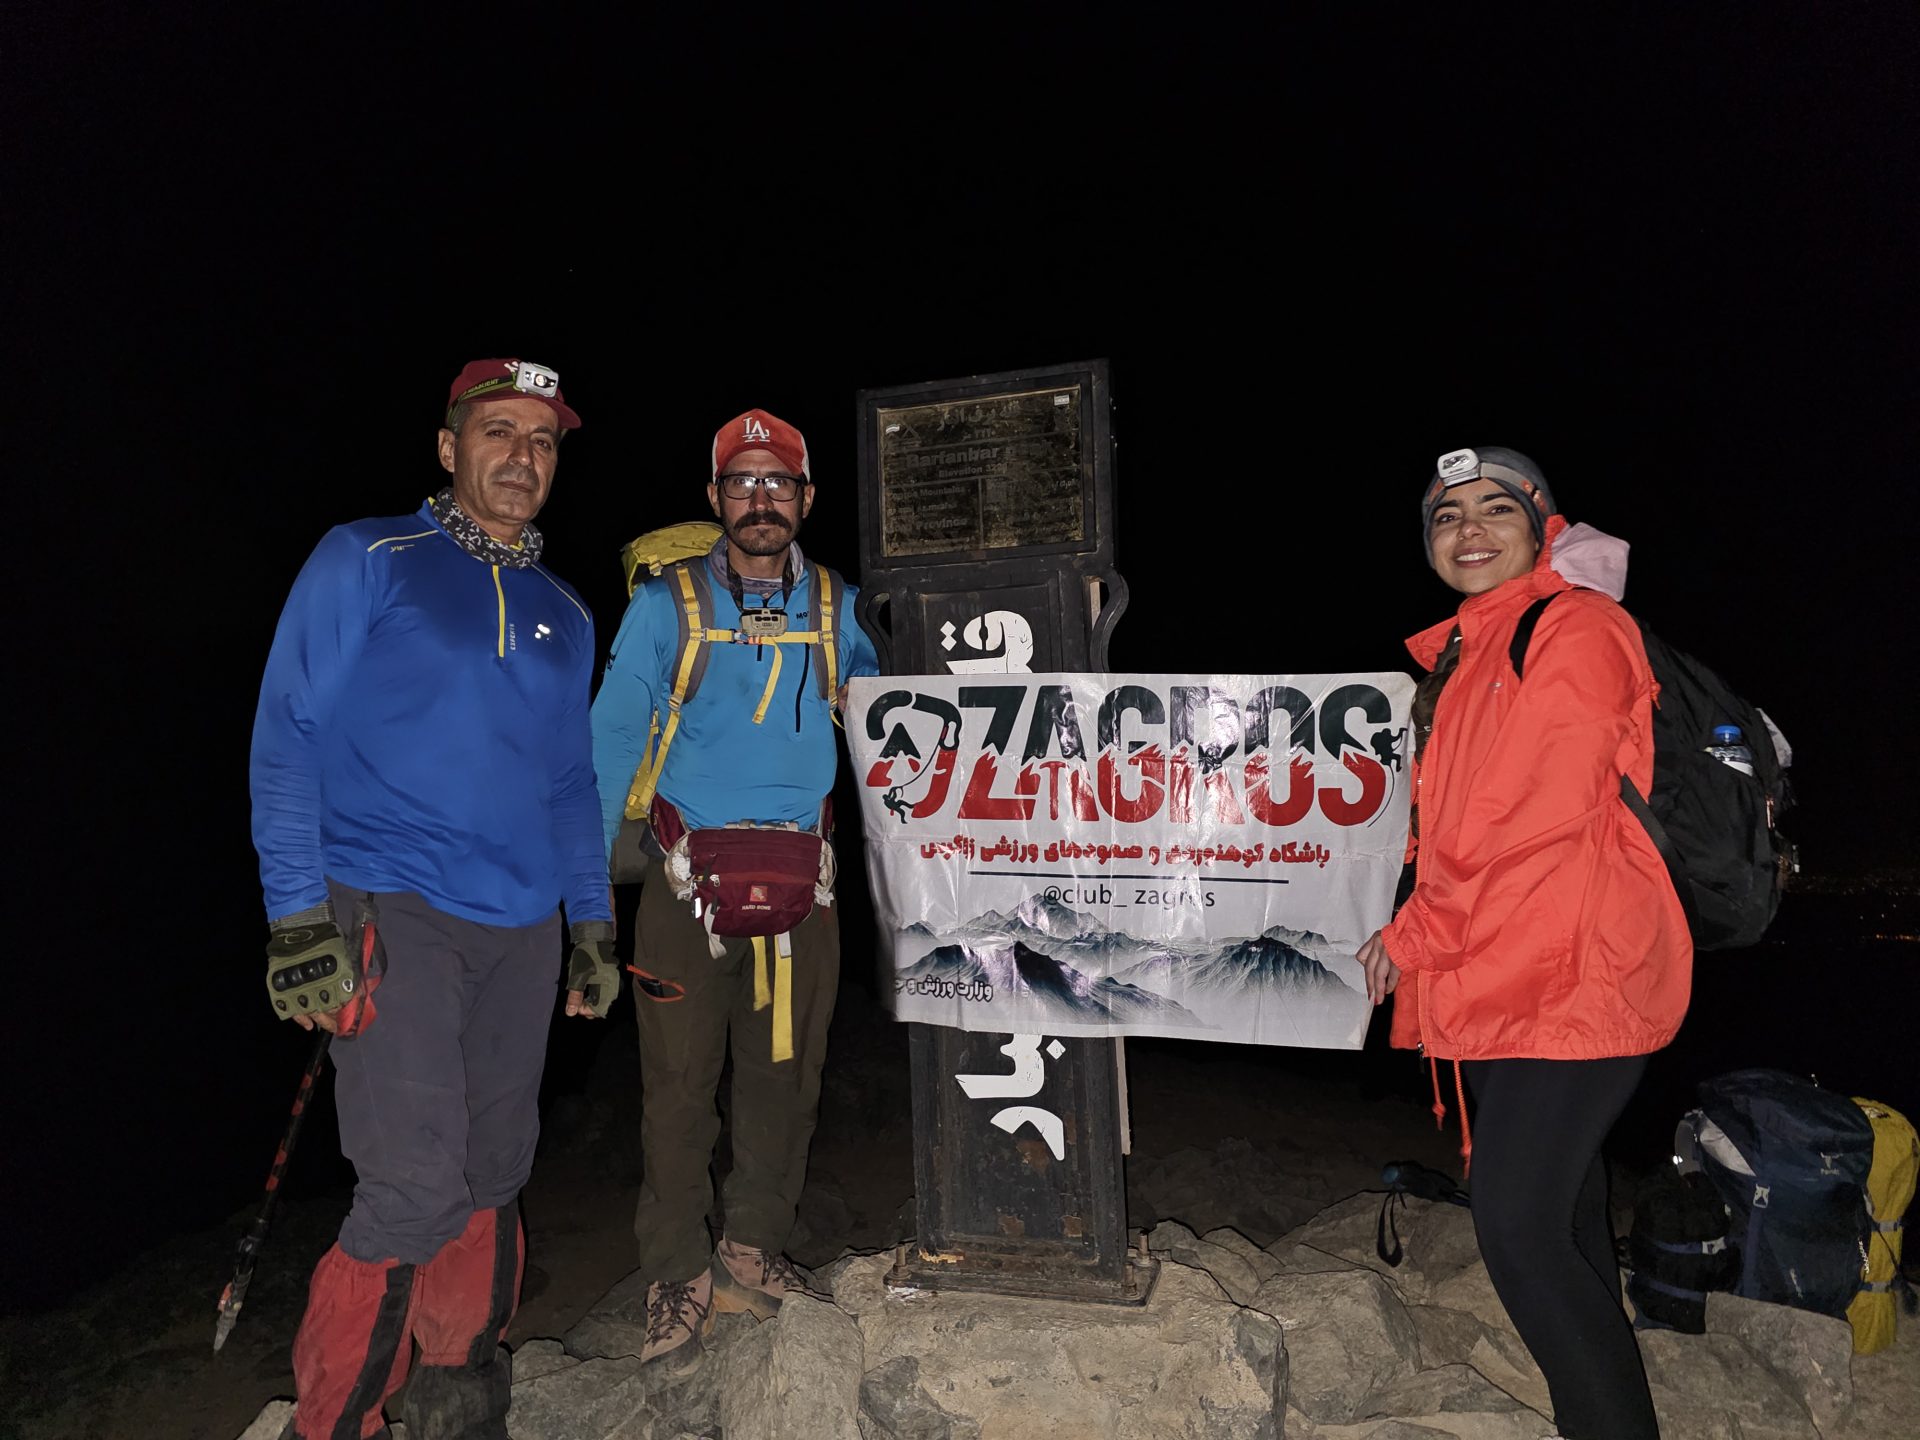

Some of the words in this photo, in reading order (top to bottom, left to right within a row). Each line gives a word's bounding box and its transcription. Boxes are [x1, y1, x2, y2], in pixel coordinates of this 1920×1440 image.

[743, 417, 770, 443] LA
[957, 685, 1391, 827] ZAGROS
[980, 835, 1039, 863] ورزشی
[1149, 846, 1160, 865] و
[1269, 841, 1330, 868] باشگاه
[917, 974, 955, 999] ورزش
[956, 980, 993, 1002] وزارت
